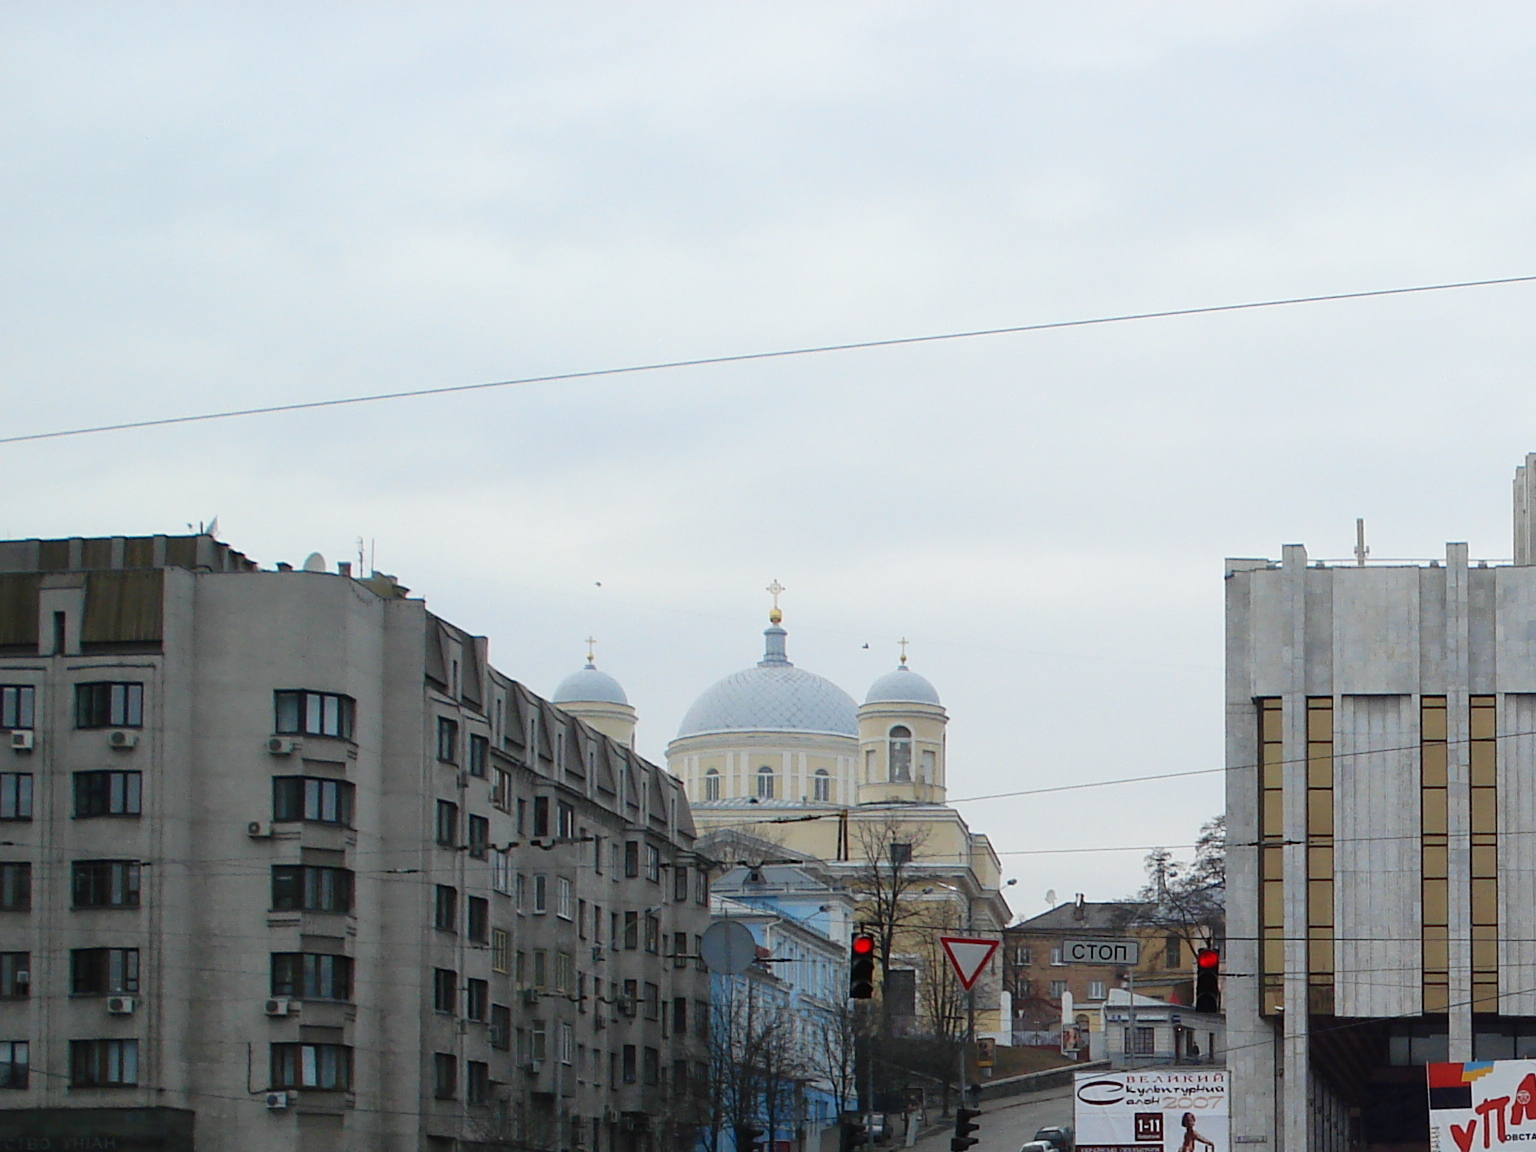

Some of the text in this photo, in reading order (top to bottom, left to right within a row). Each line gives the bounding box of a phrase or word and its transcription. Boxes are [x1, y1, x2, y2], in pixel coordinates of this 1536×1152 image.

[1072, 943, 1127, 961] СТОП
[1126, 1073, 1224, 1083] ВЕЛИКИЙ
[1162, 1096, 1224, 1109] 2007
[1138, 1119, 1160, 1133] 1-11
